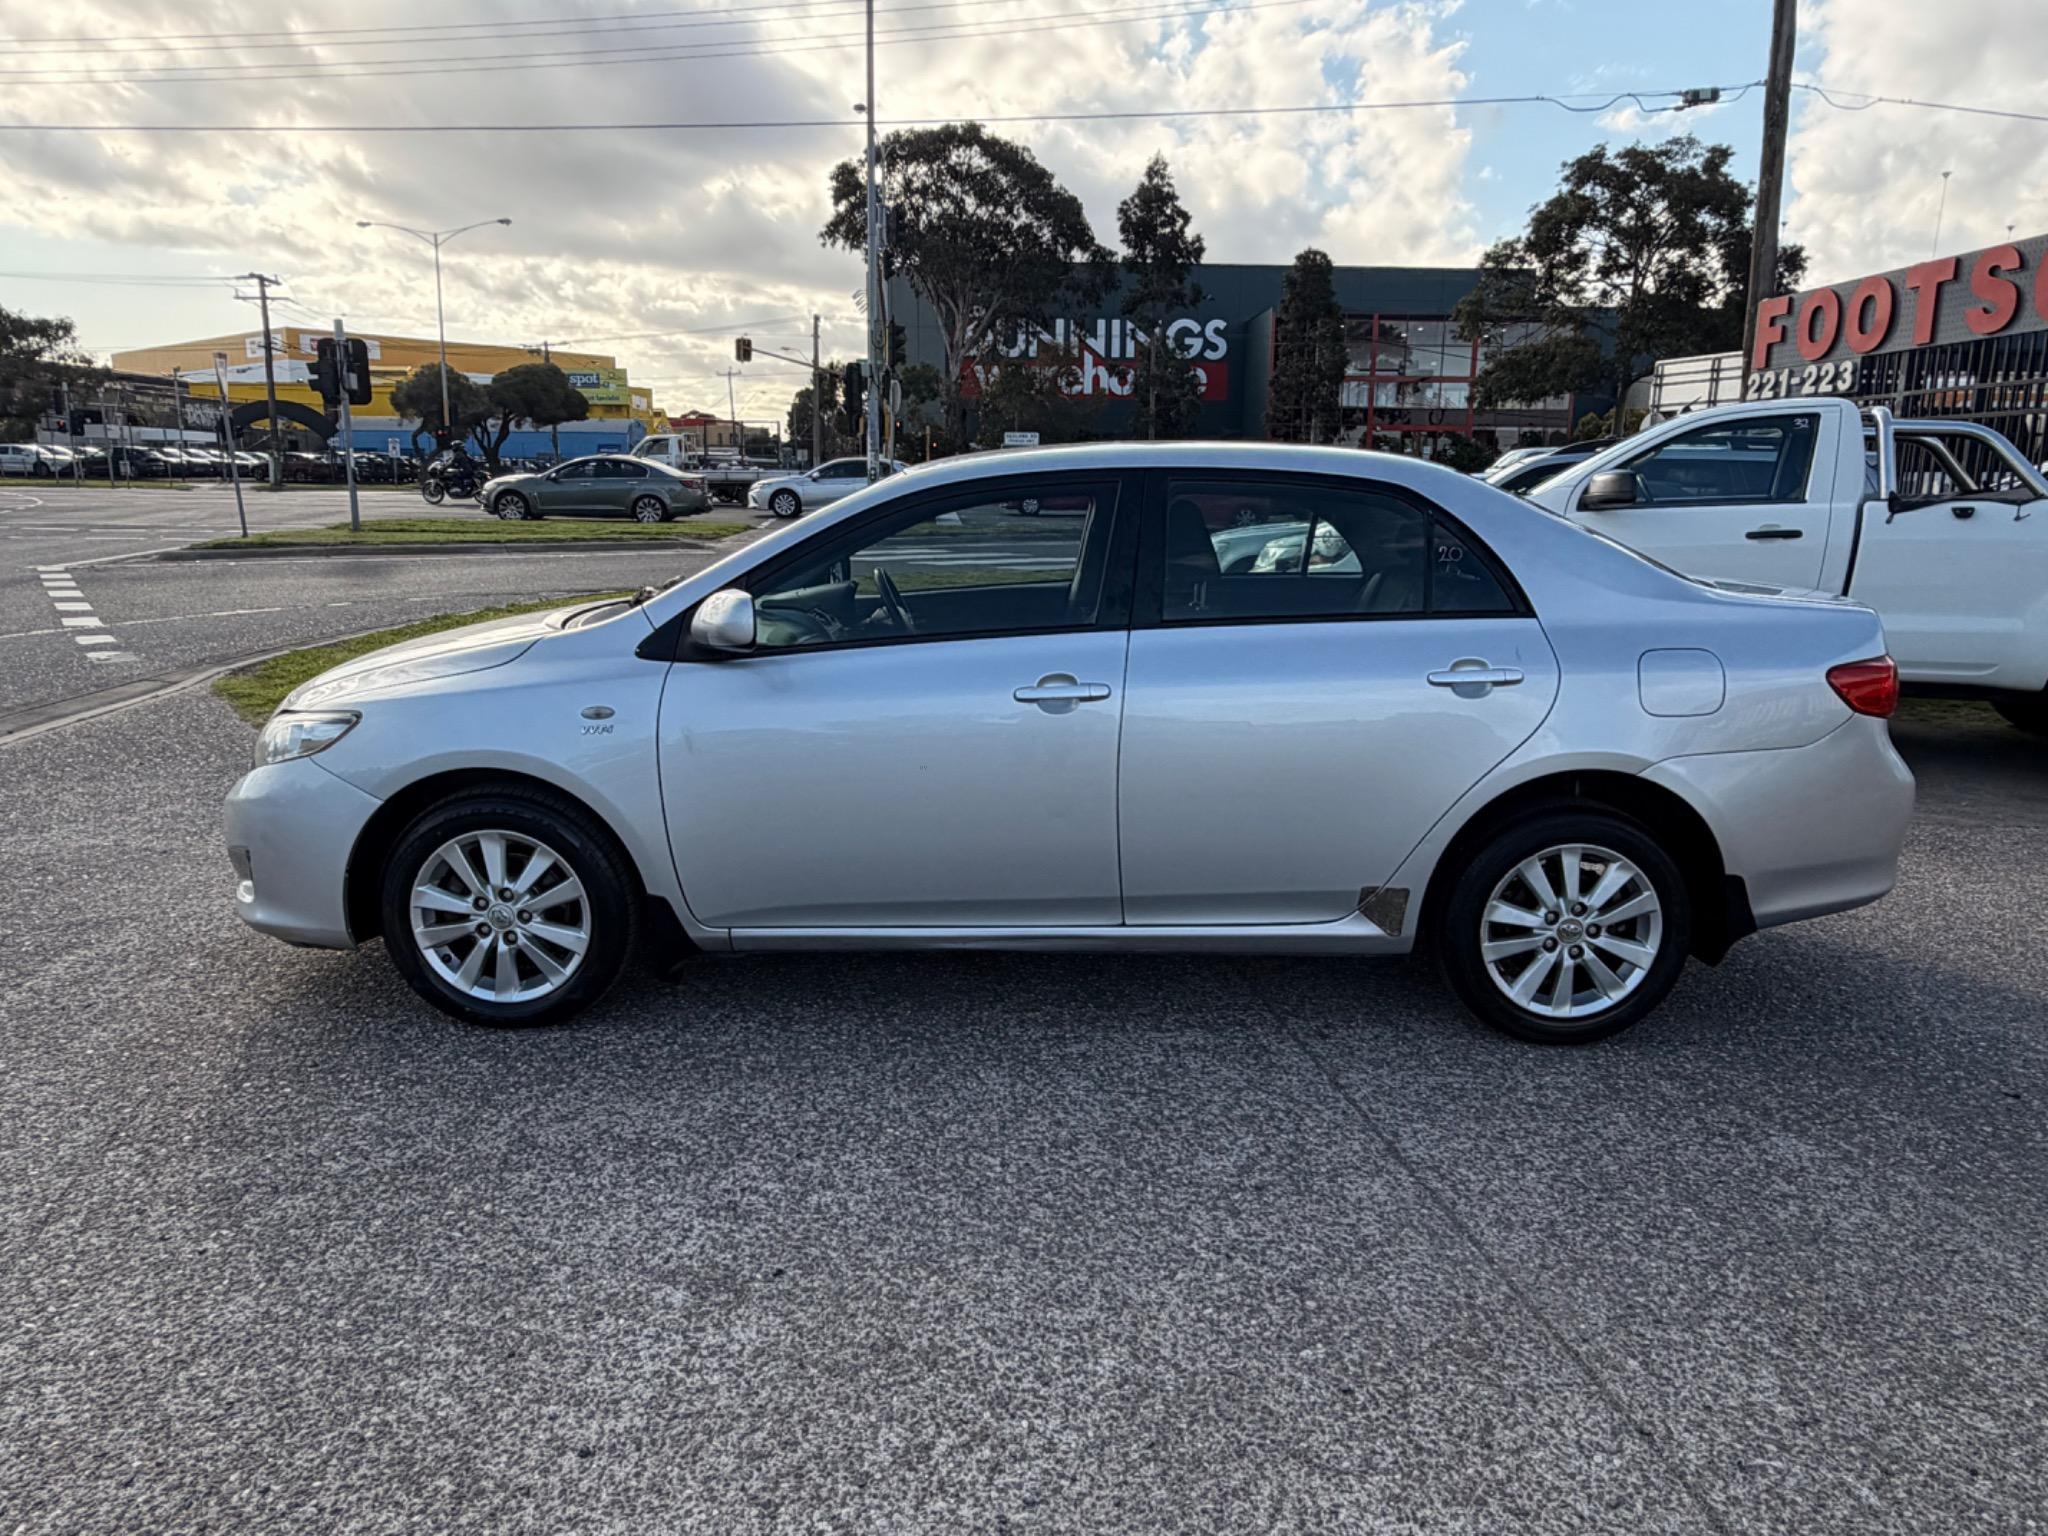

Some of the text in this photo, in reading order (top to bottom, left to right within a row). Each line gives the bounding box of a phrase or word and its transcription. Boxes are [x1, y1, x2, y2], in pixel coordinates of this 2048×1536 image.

[1752, 246, 2048, 369] FOOTS
[569, 372, 599, 386] spot
[1746, 360, 1853, 400] 221-223
